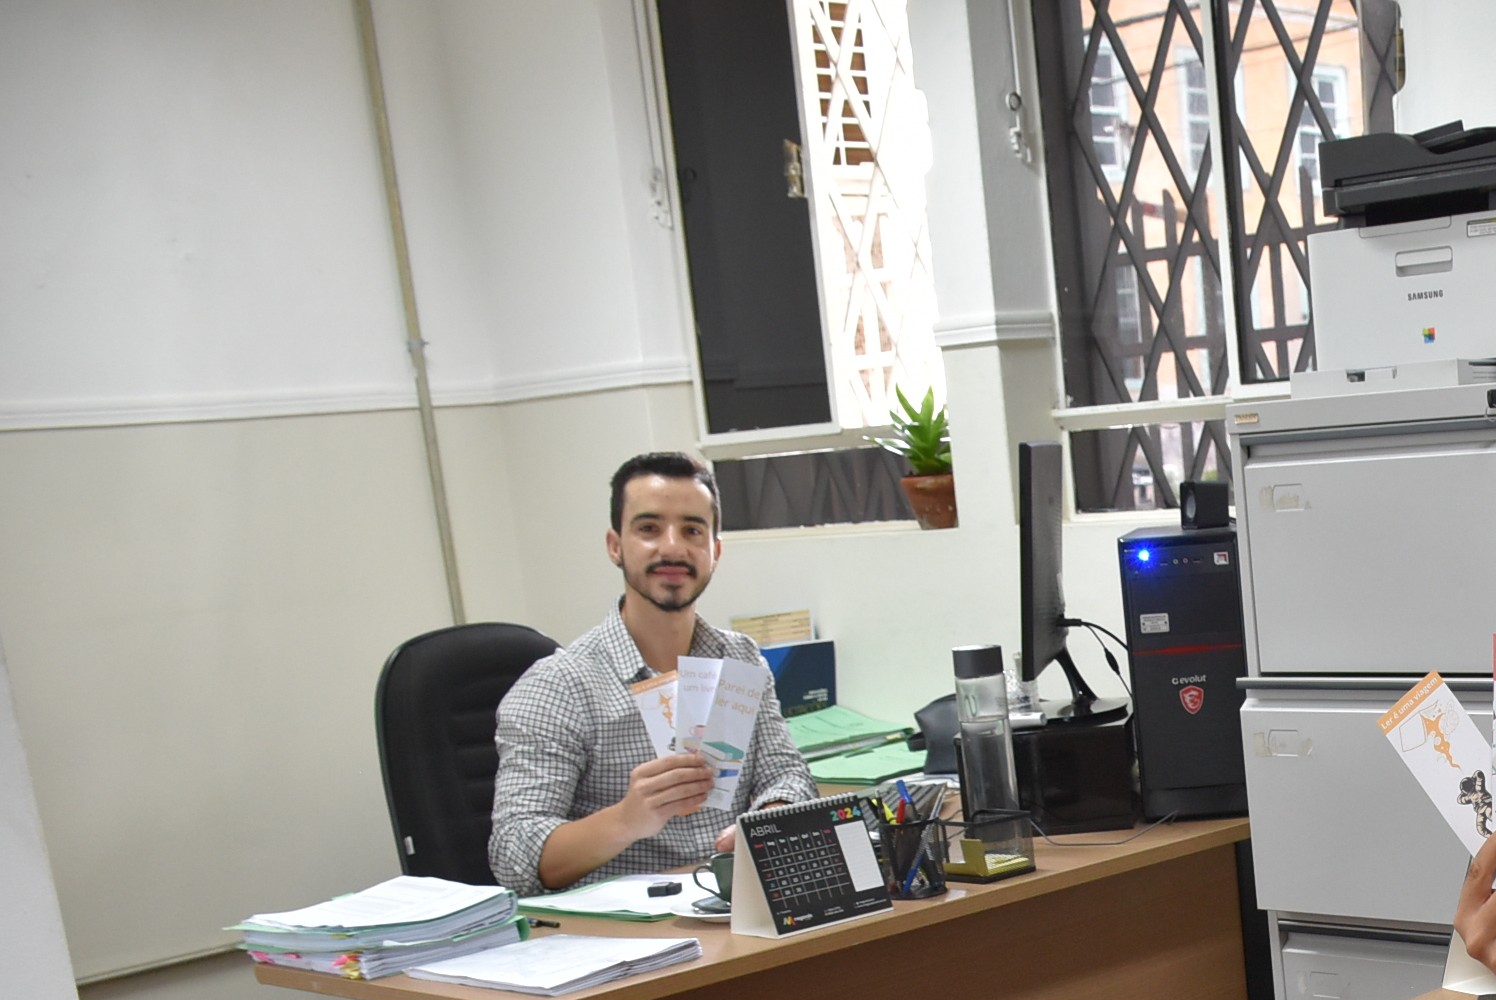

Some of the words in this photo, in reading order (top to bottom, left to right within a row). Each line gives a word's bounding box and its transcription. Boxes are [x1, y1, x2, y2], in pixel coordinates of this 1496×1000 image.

[1407, 289, 1444, 301] SAMSUNG
[1381, 716, 1394, 730] Ler
[1398, 699, 1415, 715] uma
[1413, 677, 1438, 700] viagem
[829, 806, 862, 822] 2024
[750, 824, 782, 838] ABRIL
